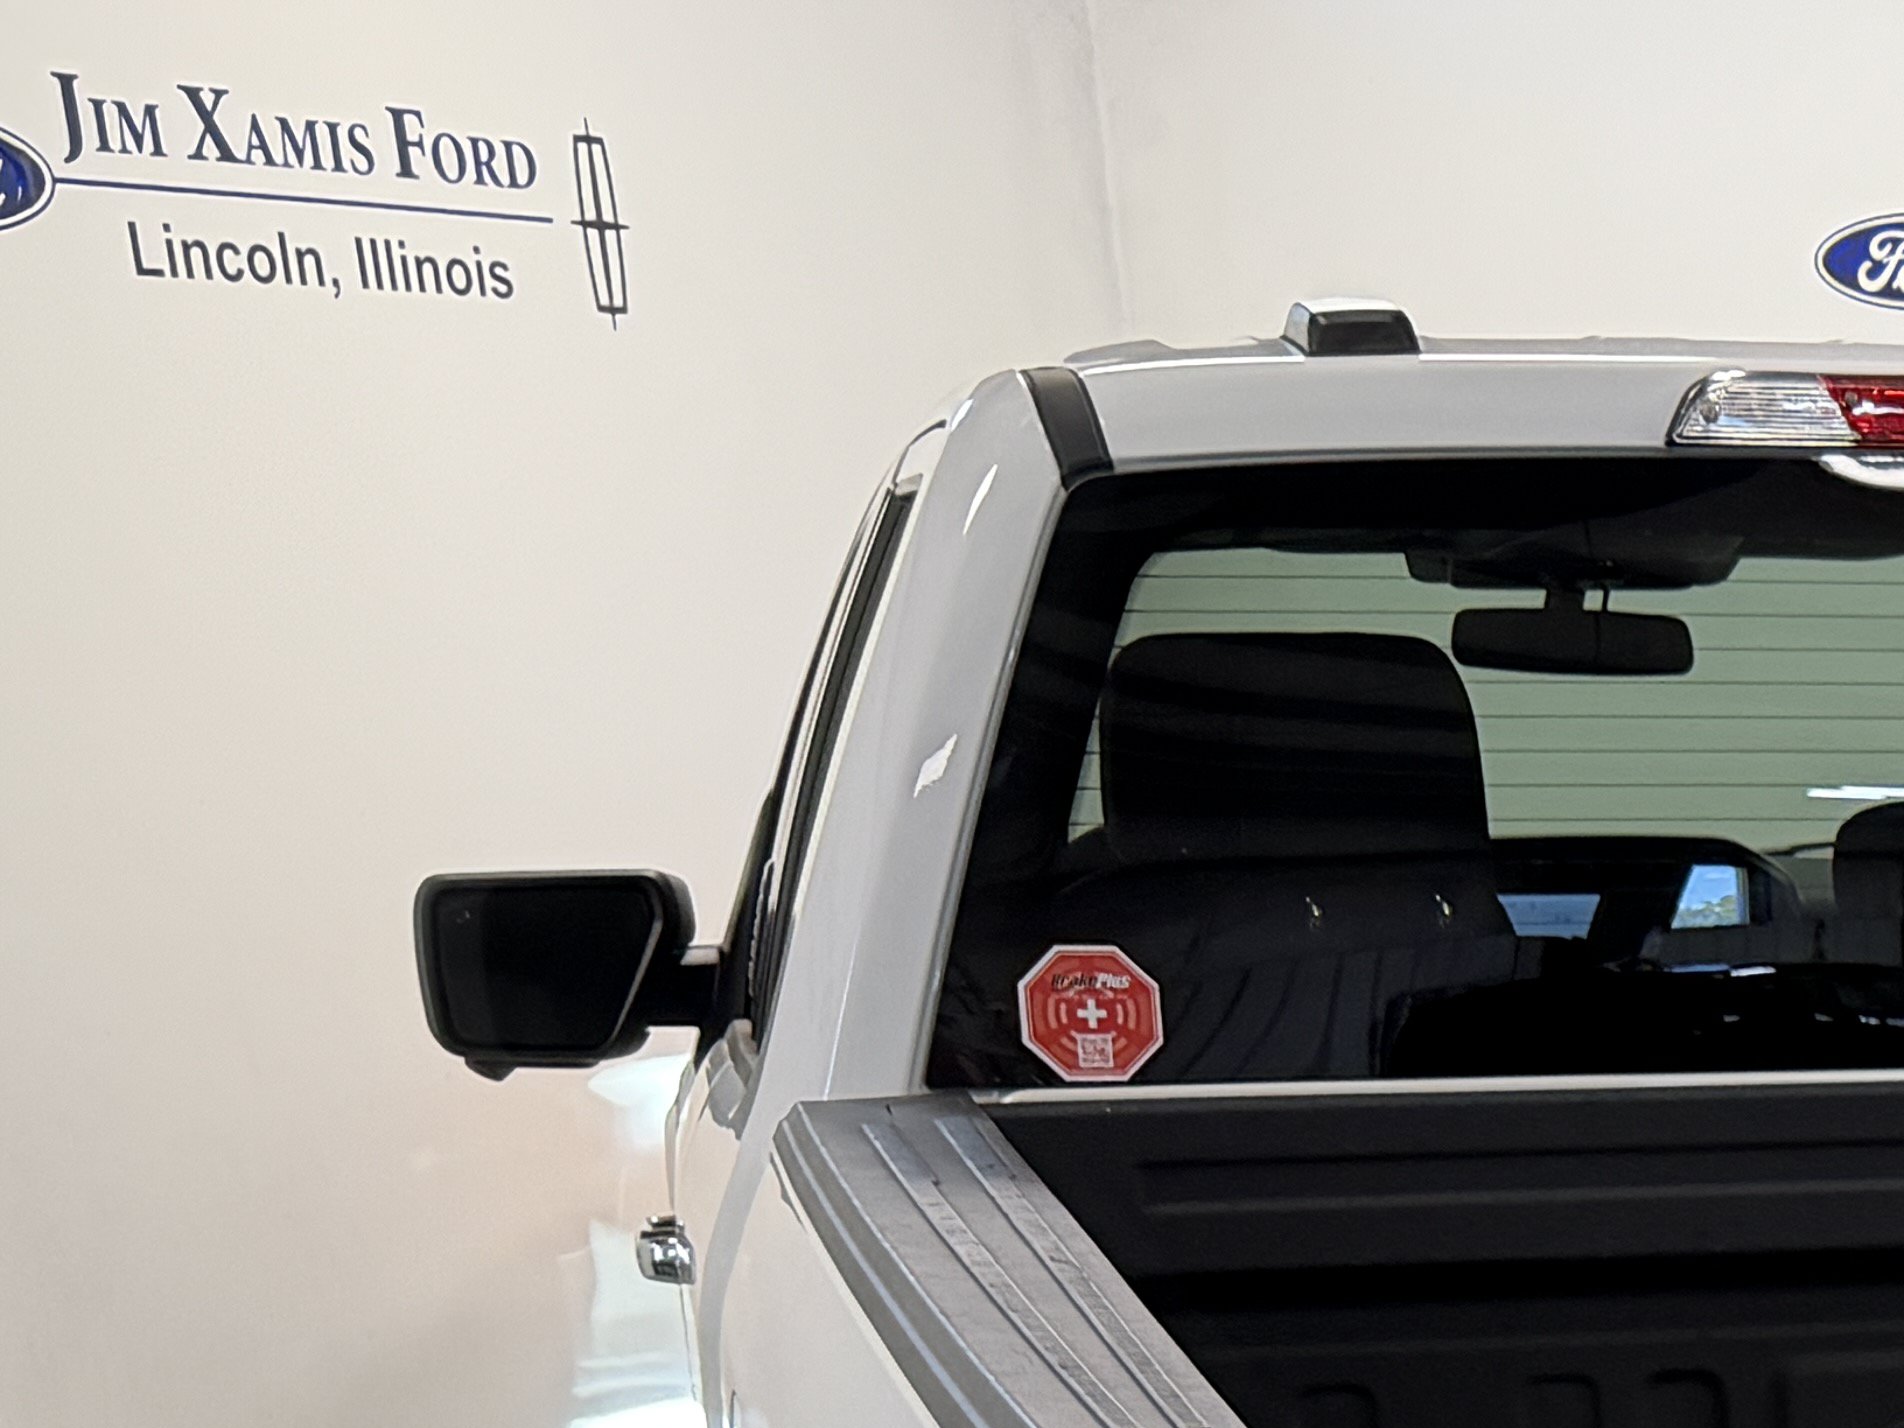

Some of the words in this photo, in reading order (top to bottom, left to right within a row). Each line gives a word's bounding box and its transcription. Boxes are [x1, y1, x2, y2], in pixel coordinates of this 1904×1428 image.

[50, 71, 168, 164] JIM
[177, 84, 375, 176] XAMIS
[385, 106, 537, 190] FORD
[127, 221, 341, 299] Lincoln,
[354, 236, 515, 299] Illinois
